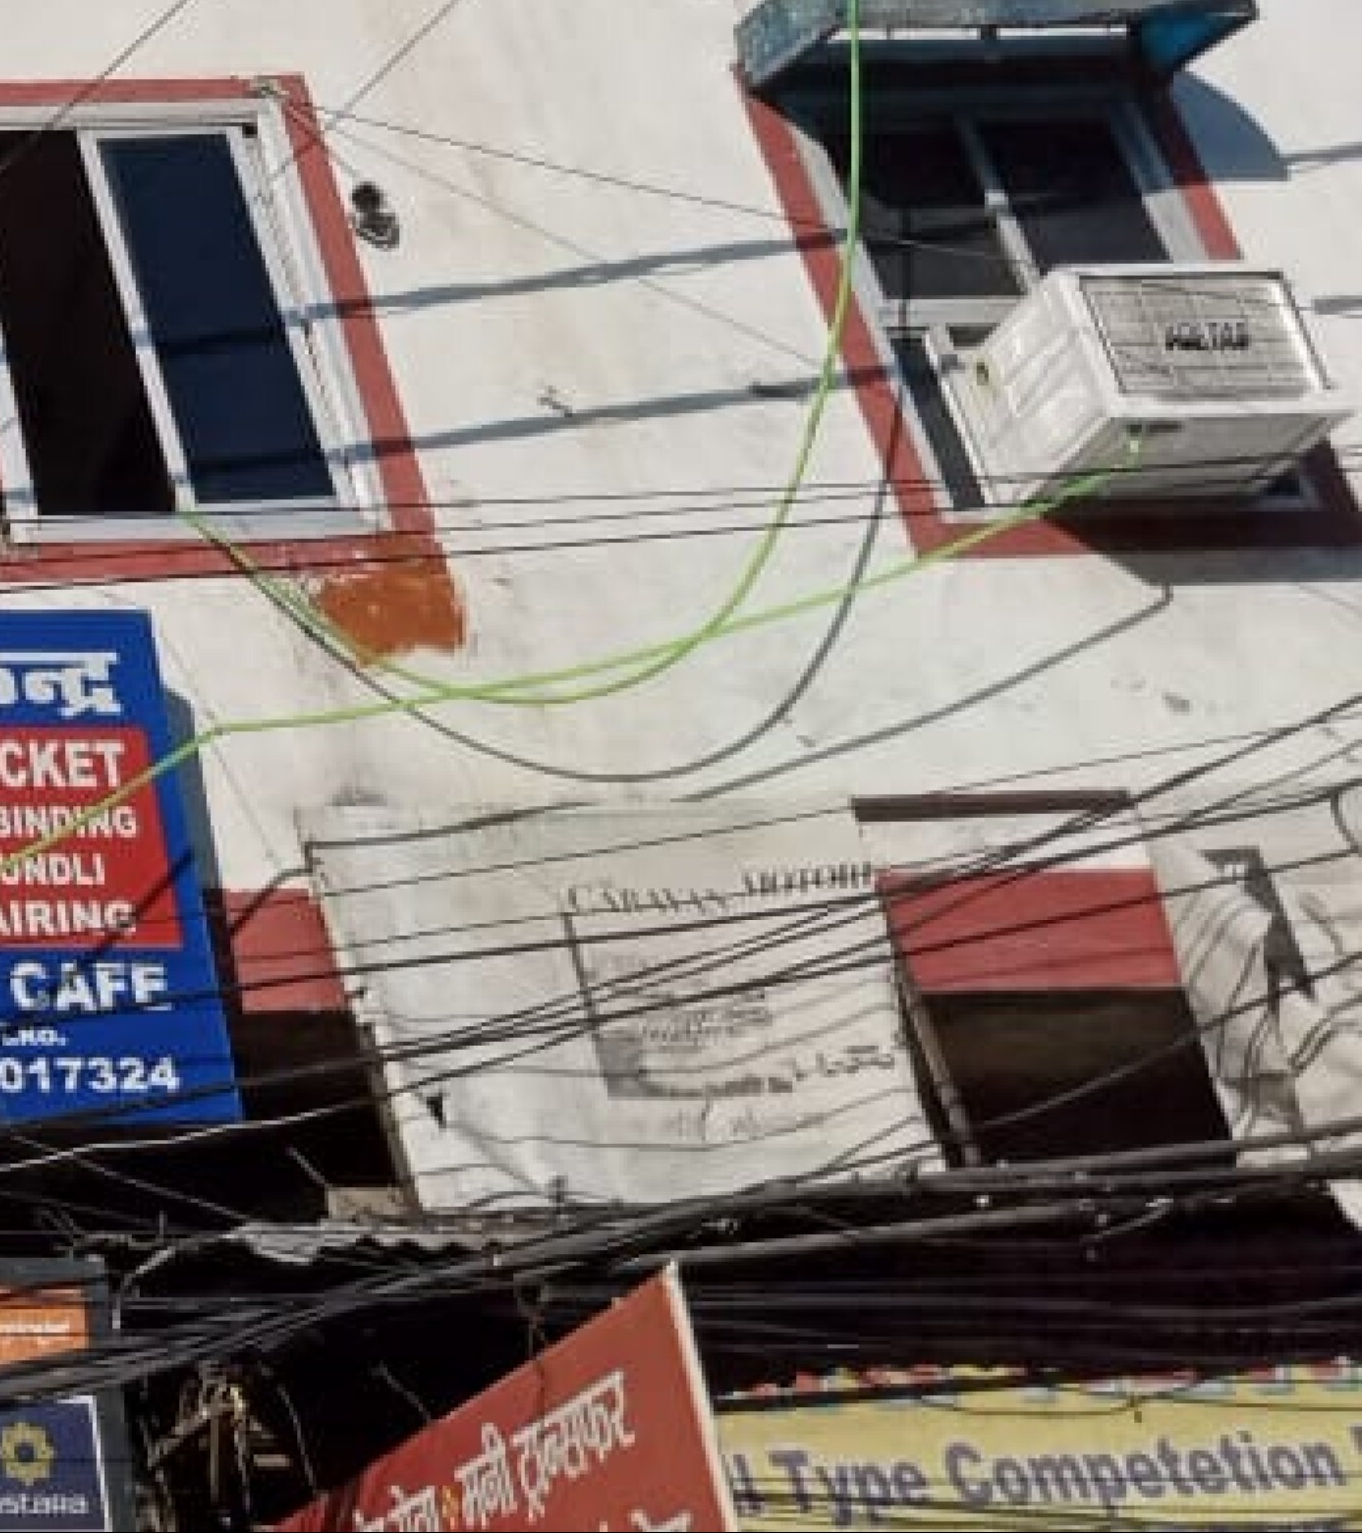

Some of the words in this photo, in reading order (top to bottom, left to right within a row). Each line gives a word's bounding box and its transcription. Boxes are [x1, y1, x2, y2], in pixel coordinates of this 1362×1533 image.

[9, 962, 173, 1012] CAFE
[767, 1448, 931, 1526] Type
[943, 1430, 1349, 1519] Competetion
